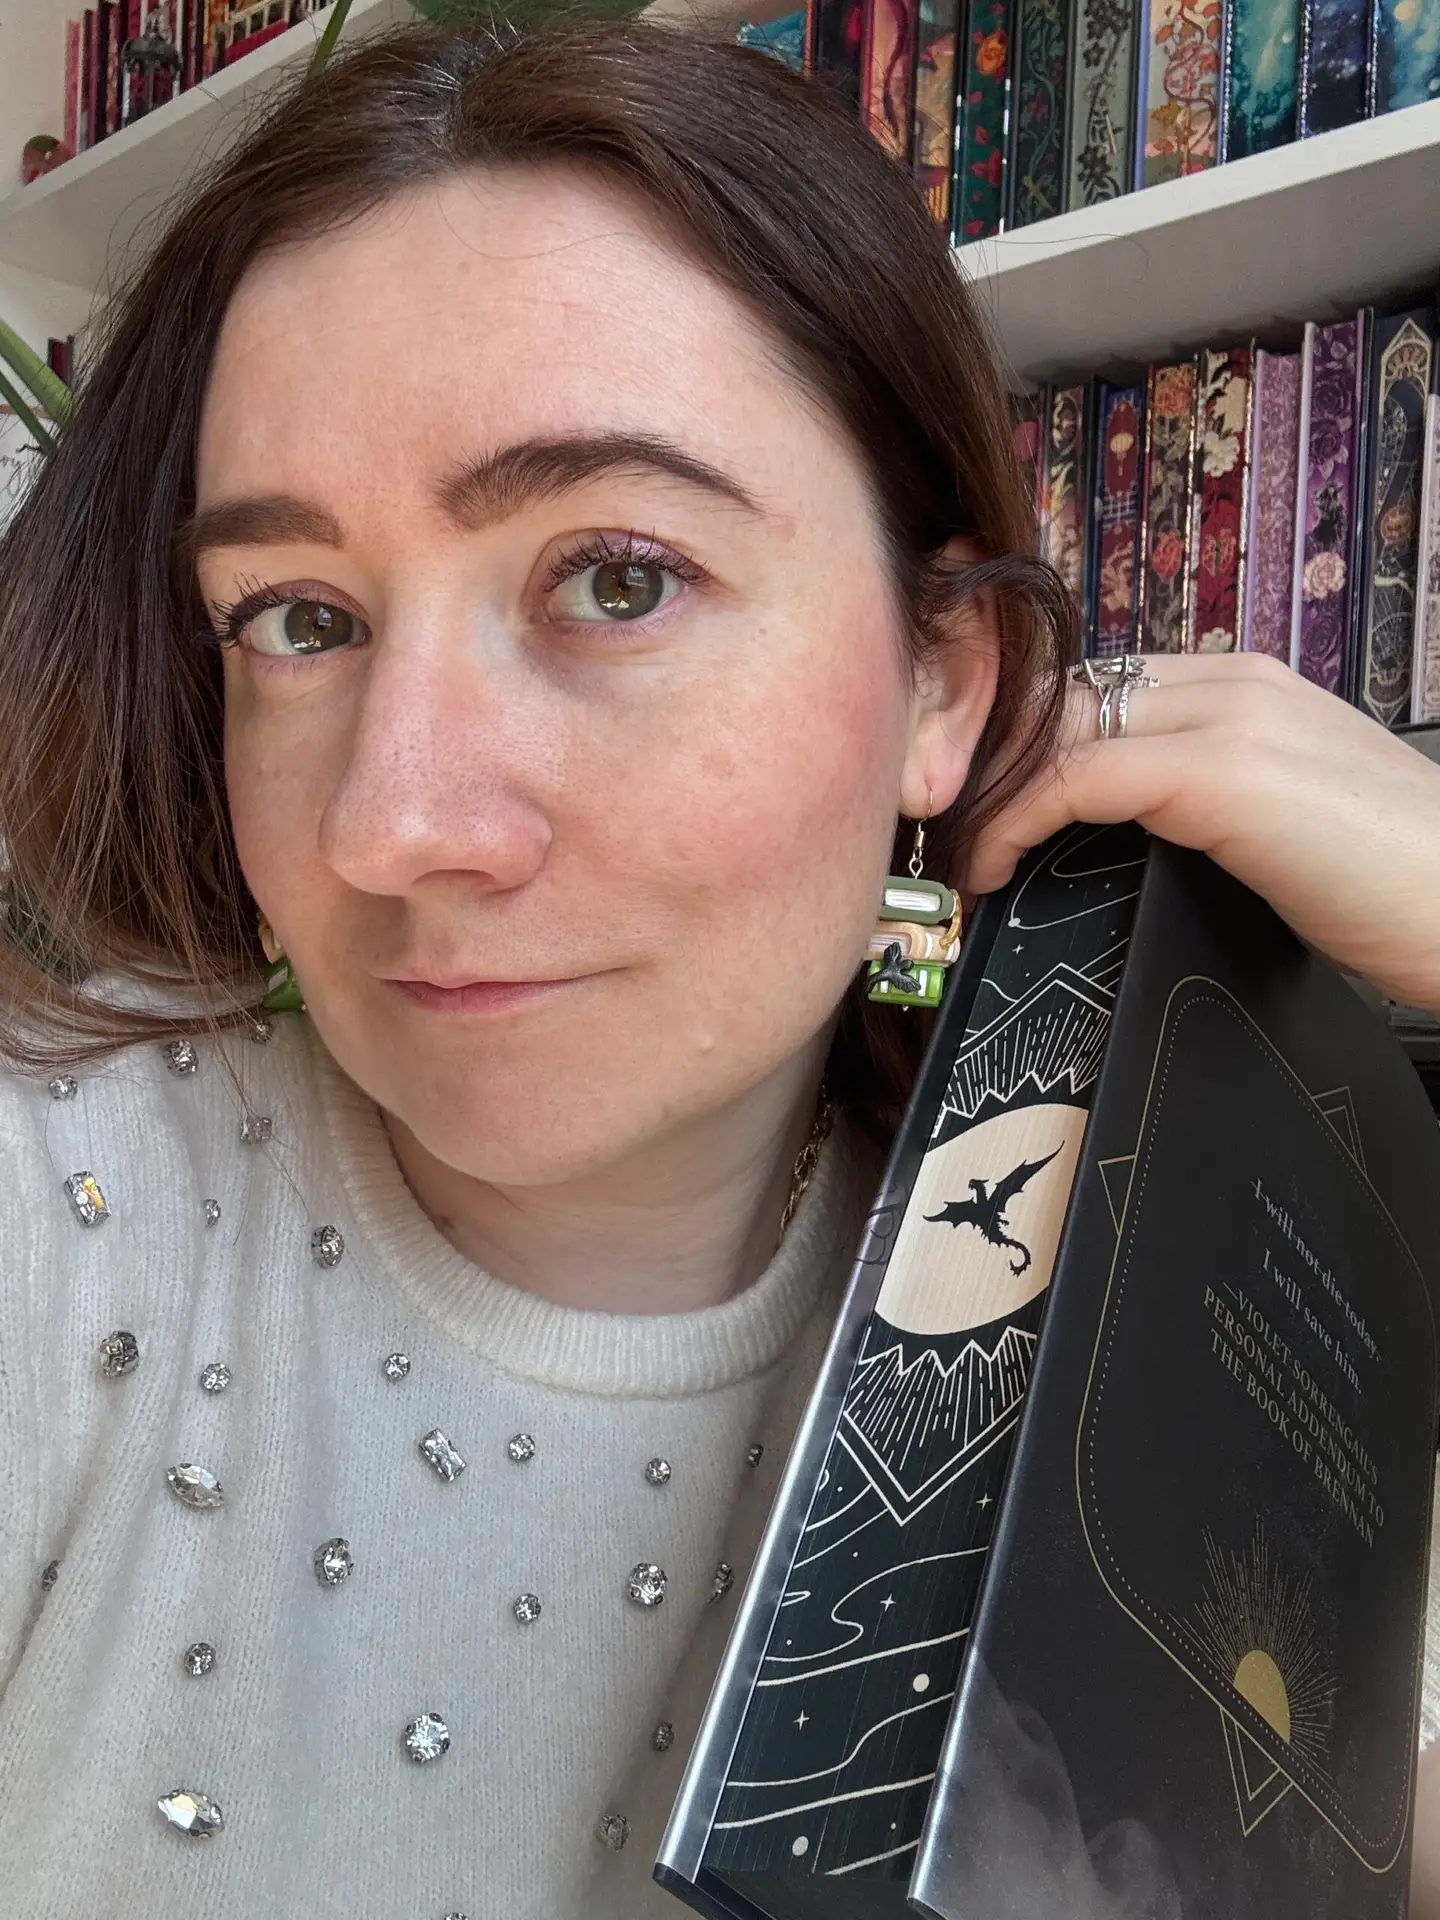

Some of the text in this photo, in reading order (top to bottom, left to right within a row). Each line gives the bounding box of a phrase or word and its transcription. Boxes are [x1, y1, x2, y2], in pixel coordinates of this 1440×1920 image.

[1255, 1177, 1263, 1200] I
[1266, 1196, 1294, 1240] will
[1296, 1237, 1320, 1275] not
[1322, 1269, 1342, 1306] die
[1263, 1248, 1362, 1395] I will save him.
[1204, 1285, 1383, 1527] PERSONAL ADDENDUM TO
[1211, 1328, 1374, 1548] THE BOOK OF BRENNAN
